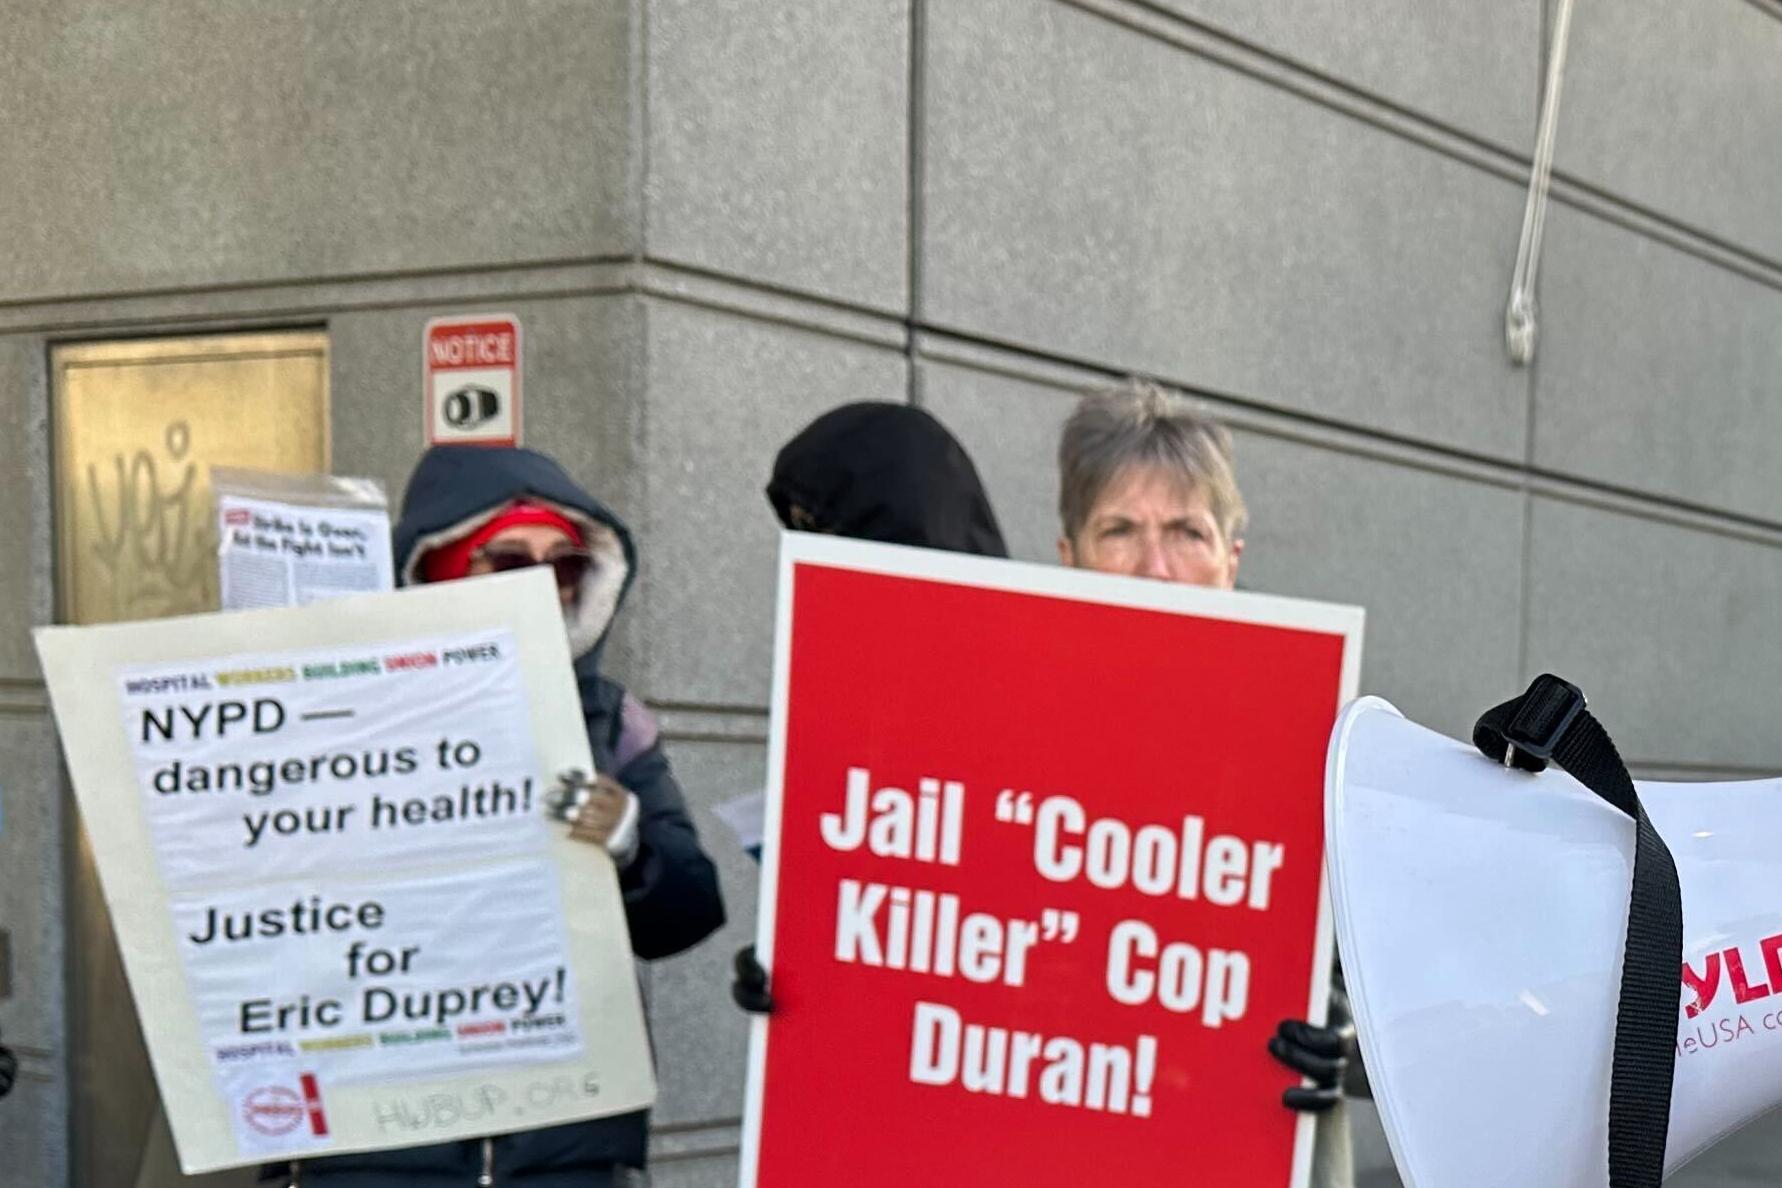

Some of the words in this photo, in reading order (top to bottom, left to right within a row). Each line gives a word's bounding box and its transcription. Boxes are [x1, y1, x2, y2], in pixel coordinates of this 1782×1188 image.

[432, 331, 512, 365] NOTICE
[141, 697, 286, 744] NYPD
[152, 744, 418, 796] dangerous
[437, 737, 482, 771] to
[243, 803, 358, 848] your
[370, 777, 534, 829] health!
[820, 766, 965, 866] Jail
[995, 788, 1285, 912] “Cooler
[189, 897, 386, 944] Justice
[345, 940, 421, 979] for
[834, 878, 1080, 988] Killer”
[1106, 918, 1251, 1029] Cop
[240, 995, 343, 1034] Eric
[362, 965, 568, 1025] Duprey!
[909, 1001, 1158, 1118] Duran!
